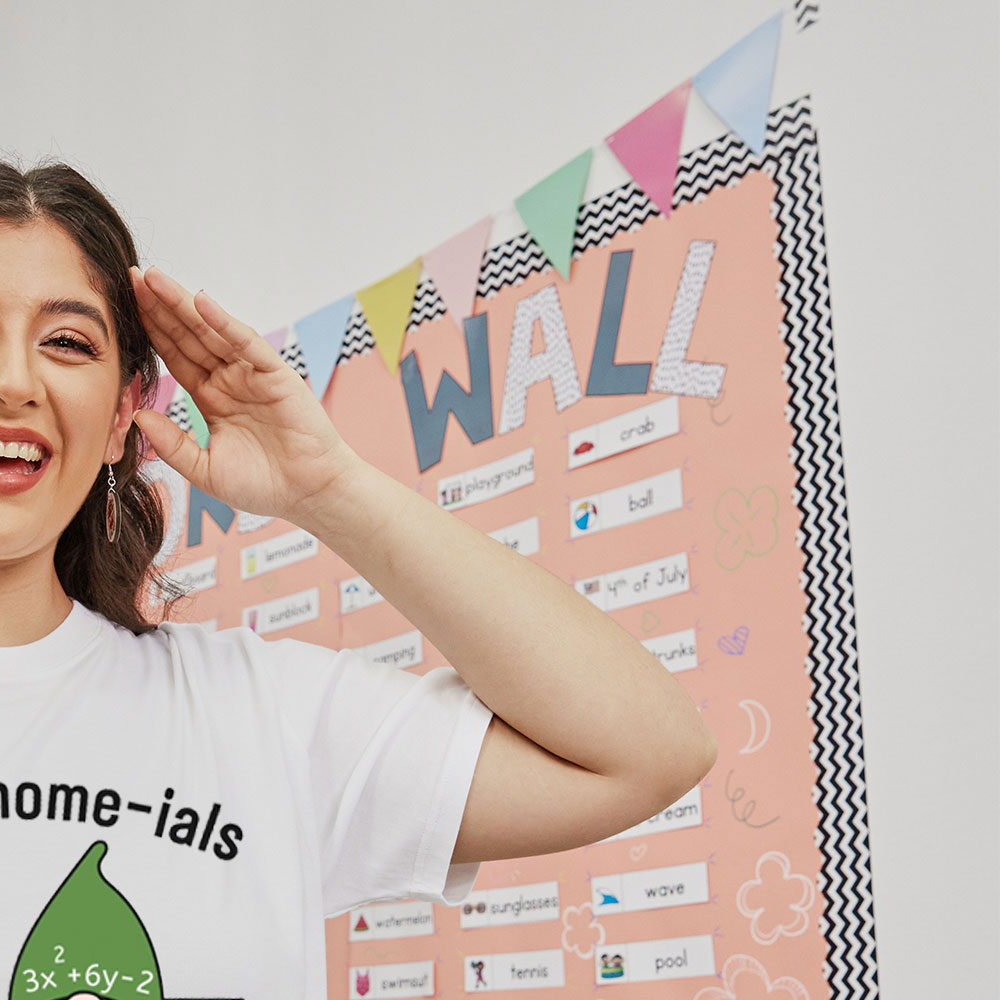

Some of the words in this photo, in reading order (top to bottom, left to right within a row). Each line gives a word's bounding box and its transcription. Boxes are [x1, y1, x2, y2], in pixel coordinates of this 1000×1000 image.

[400, 240, 727, 473] WALL
[620, 416, 656, 442] crab
[464, 456, 534, 495] playground
[628, 489, 654, 512] ball
[264, 534, 313, 562] lemonade
[633, 571, 650, 593] of
[656, 564, 689, 588] July
[644, 883, 685, 898] wave
[490, 894, 558, 917] sunglasses
[510, 964, 549, 980] tennis
[655, 948, 688, 975] pool
